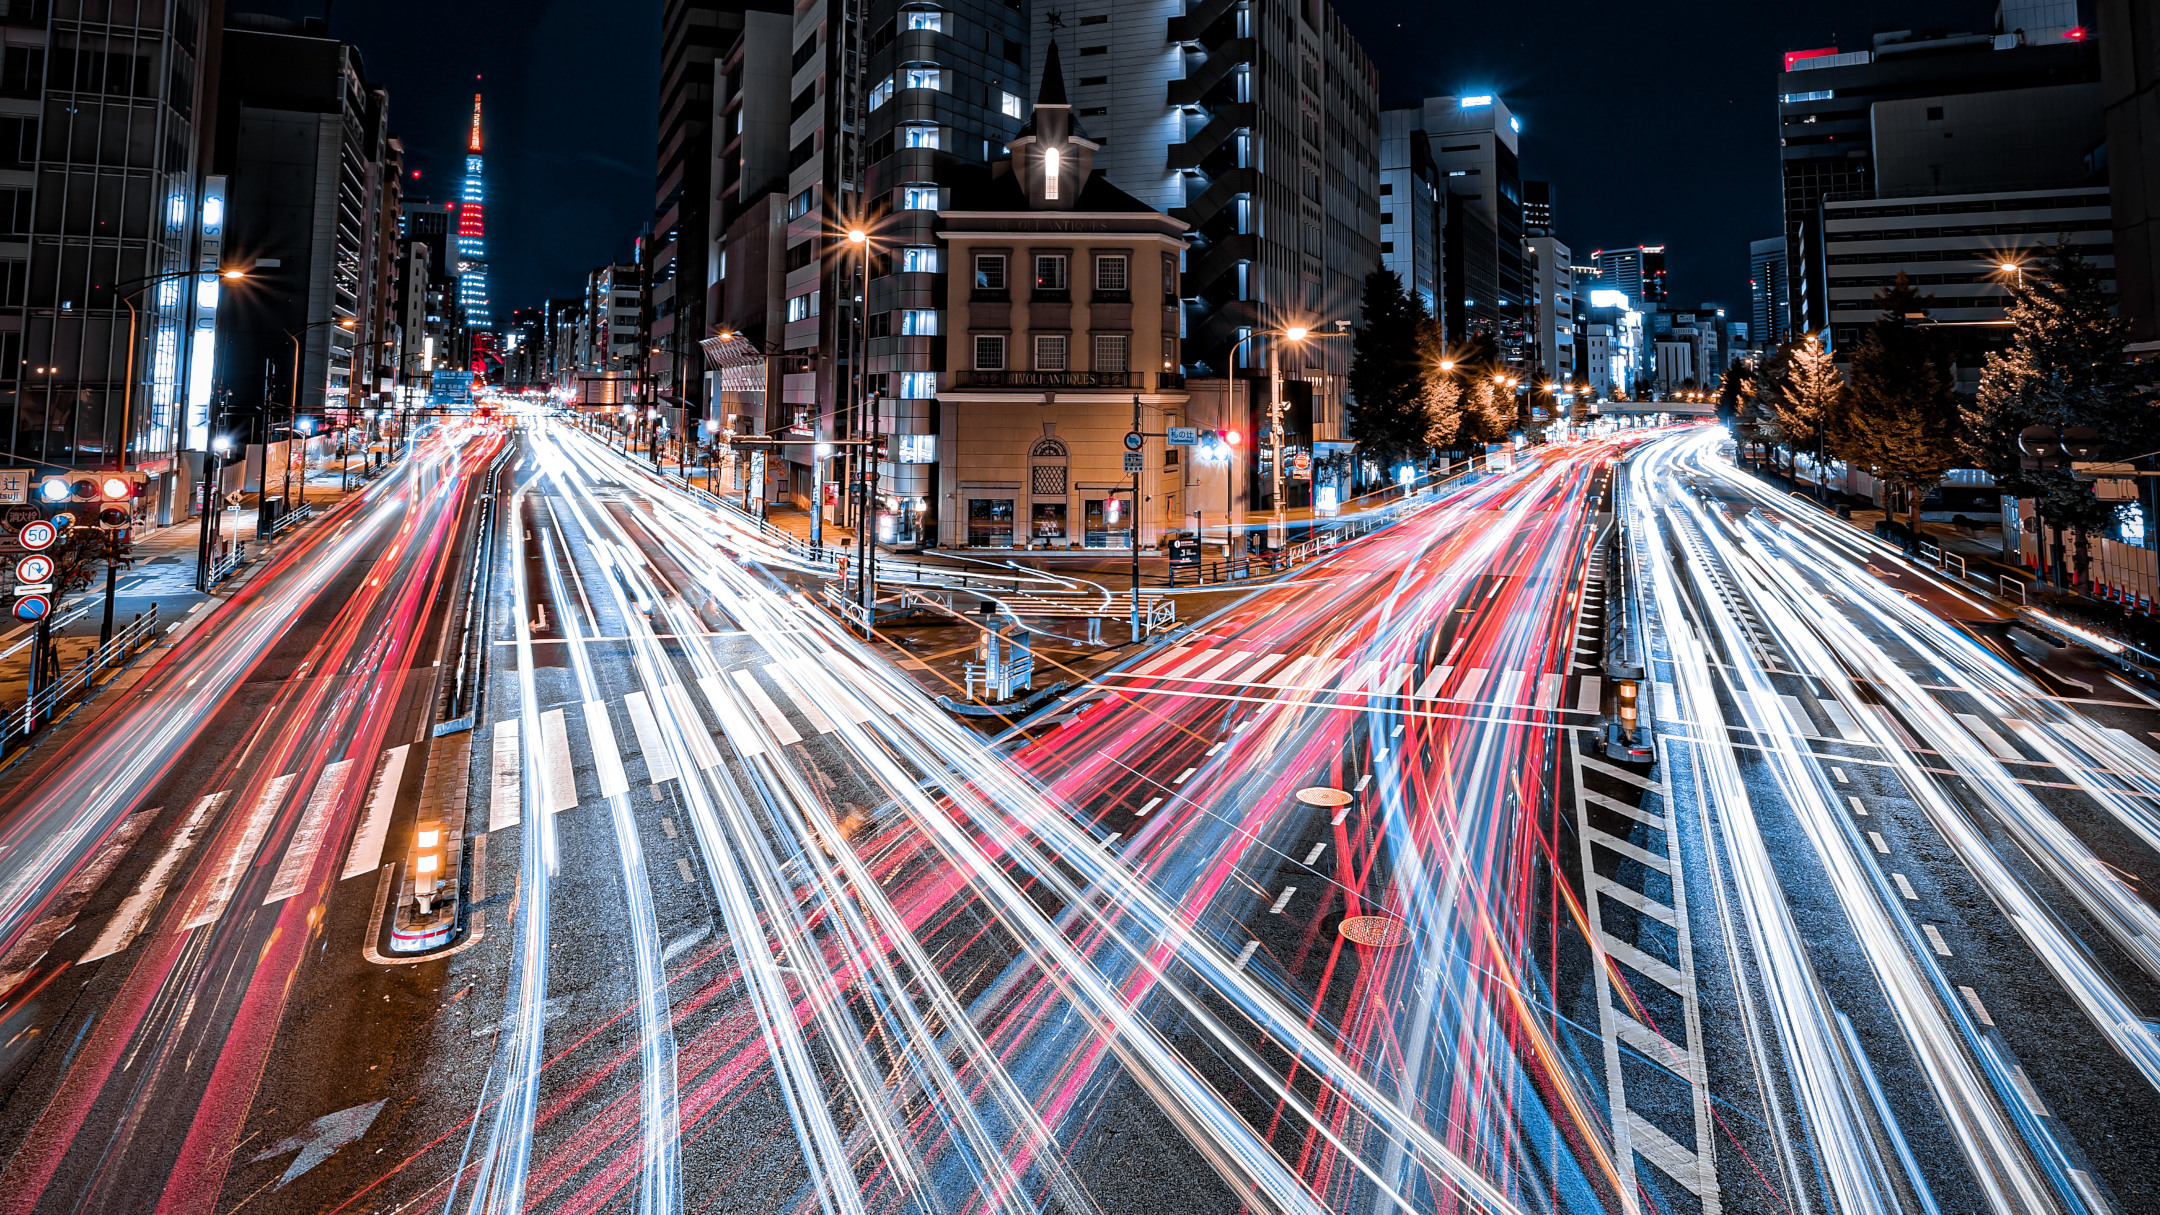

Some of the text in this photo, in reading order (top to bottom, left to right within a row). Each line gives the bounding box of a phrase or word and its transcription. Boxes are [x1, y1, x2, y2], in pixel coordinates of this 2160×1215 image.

[199, 226, 220, 308] SEITOU
[1008, 374, 1096, 385] RIVOLI ANTIQUES
[0, 476, 20, 491] 辻
[10, 511, 38, 522] 消火栓
[28, 529, 48, 542] 50
